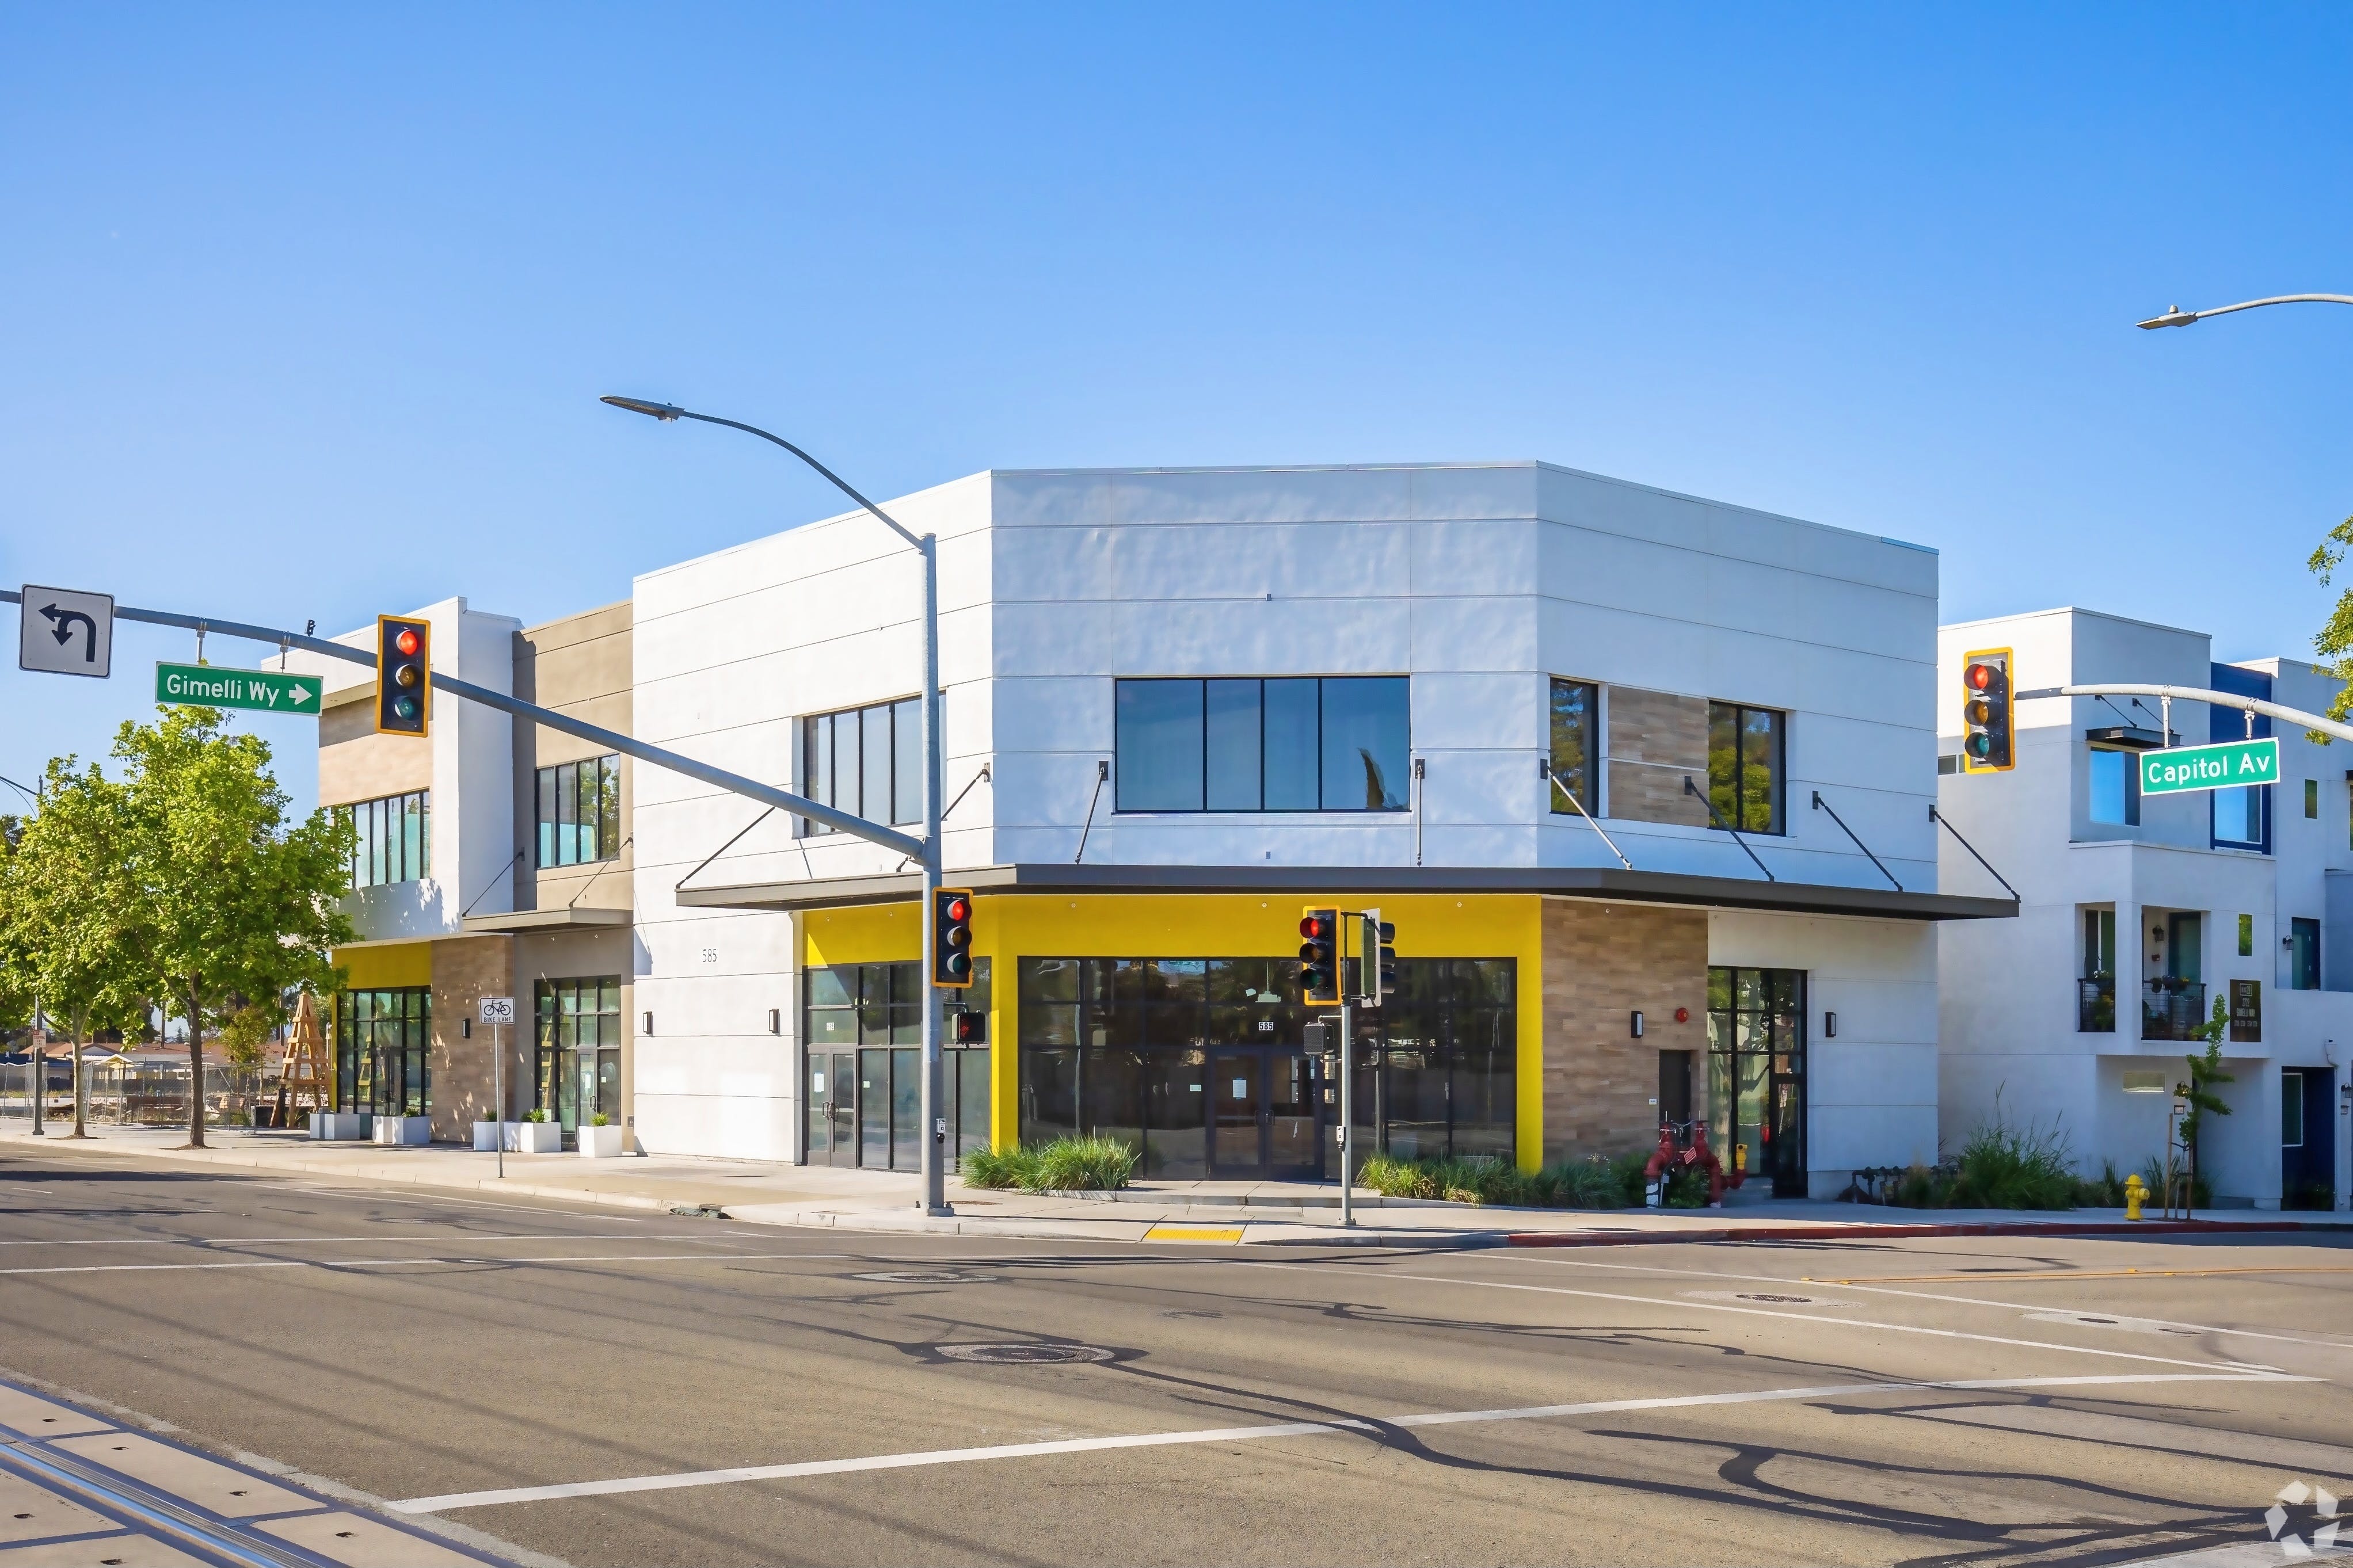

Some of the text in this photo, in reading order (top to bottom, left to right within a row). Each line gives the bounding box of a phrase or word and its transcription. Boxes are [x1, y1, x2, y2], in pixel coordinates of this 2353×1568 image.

[167, 674, 280, 707] Gimelli Wy
[2148, 753, 2270, 785] Capitol Av
[702, 948, 717, 963] 585
[1259, 1022, 1273, 1030] 585
